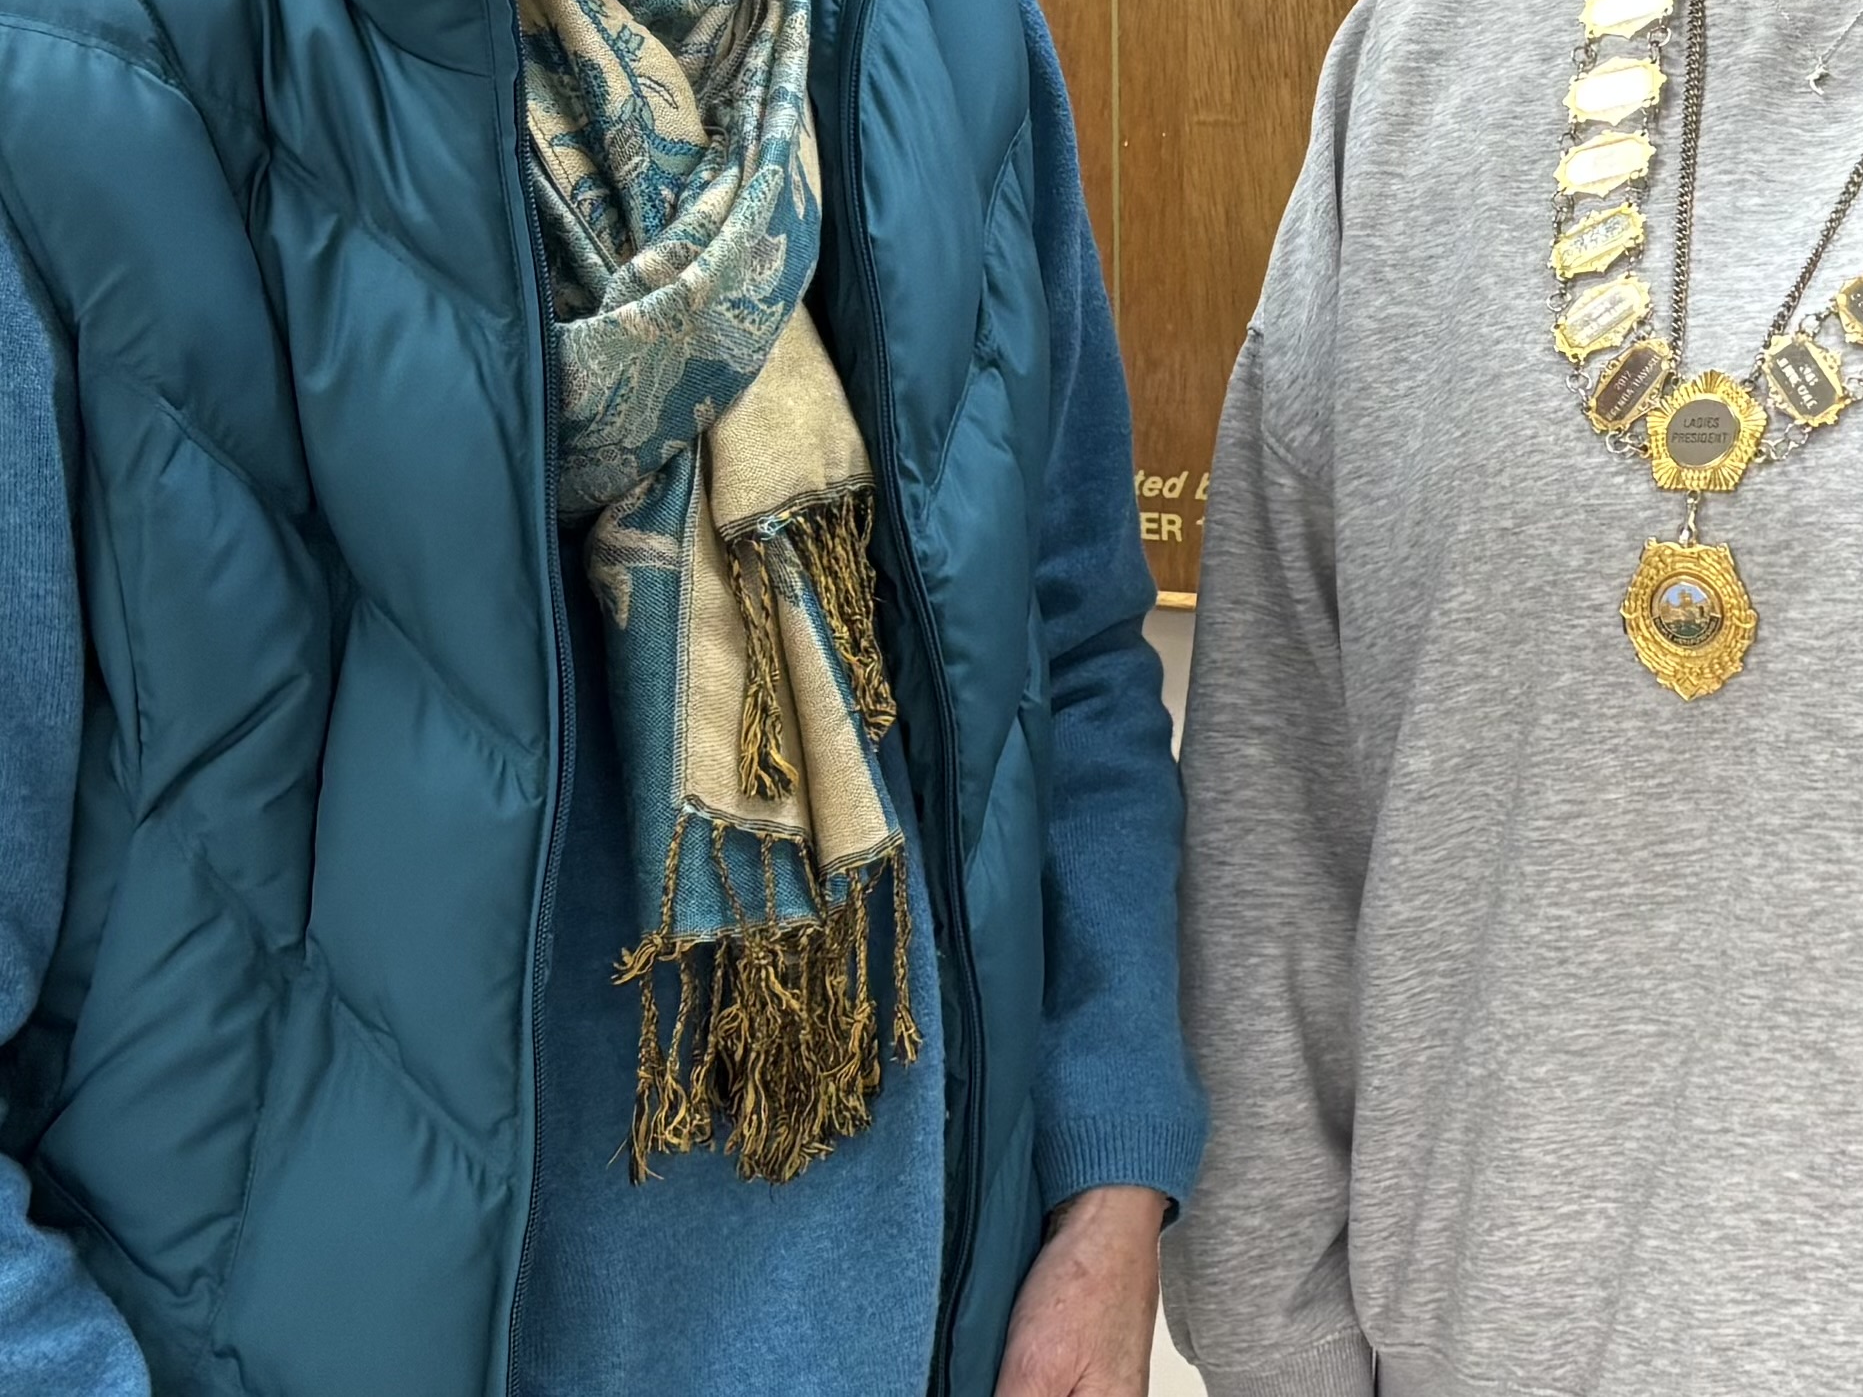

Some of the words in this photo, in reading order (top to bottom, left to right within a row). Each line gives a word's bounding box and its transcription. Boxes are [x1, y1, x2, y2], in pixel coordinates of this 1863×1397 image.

[1684, 417, 1720, 429] LADIES
[1671, 432, 1728, 444] PRESIDENT
[1133, 469, 1189, 499] ted
[1140, 511, 1182, 542] ER
